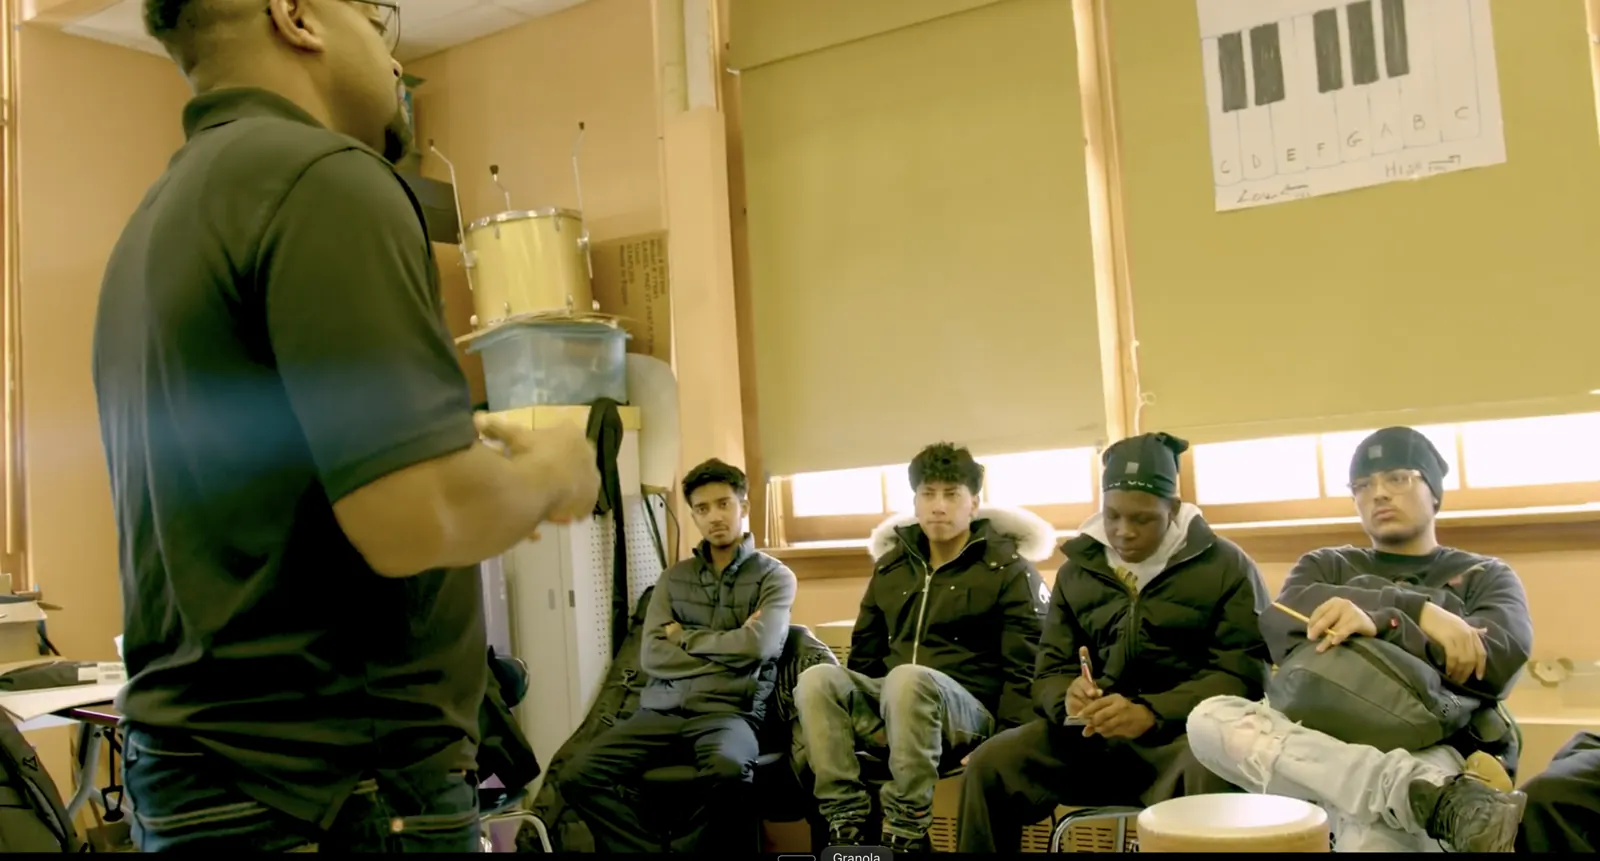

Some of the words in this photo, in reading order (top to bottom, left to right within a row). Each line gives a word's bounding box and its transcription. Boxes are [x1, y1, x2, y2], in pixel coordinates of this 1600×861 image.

[1219, 160, 1231, 174] C
[1252, 153, 1262, 169] D
[1286, 147, 1297, 162] E
[1317, 142, 1326, 158] F
[1346, 130, 1363, 148] G
[1380, 122, 1392, 138] A
[1412, 113, 1426, 131] B
[1454, 105, 1469, 120] C
